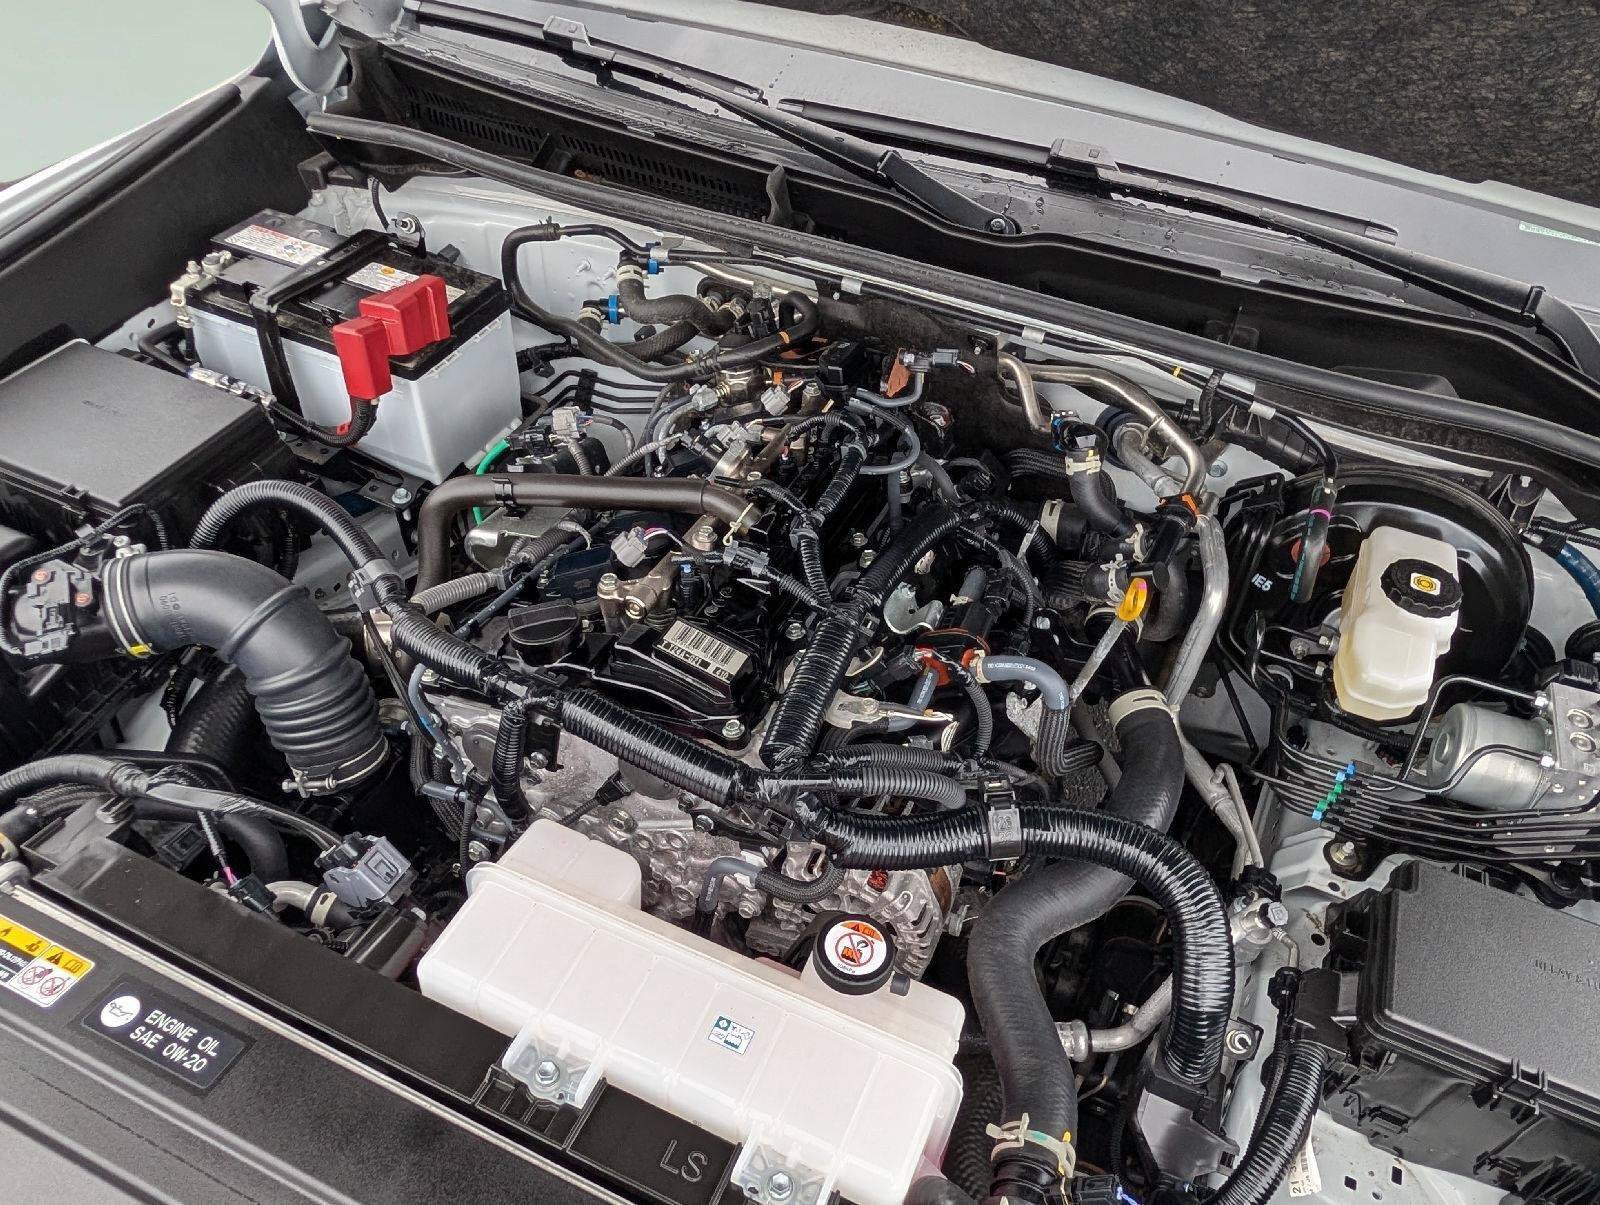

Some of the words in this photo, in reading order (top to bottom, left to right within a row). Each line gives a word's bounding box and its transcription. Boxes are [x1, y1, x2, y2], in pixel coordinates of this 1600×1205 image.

[129, 1026, 164, 1049] SAE
[144, 1009, 198, 1043] ENGINE
[197, 1036, 220, 1057] OIL
[660, 1139, 708, 1182] LS
